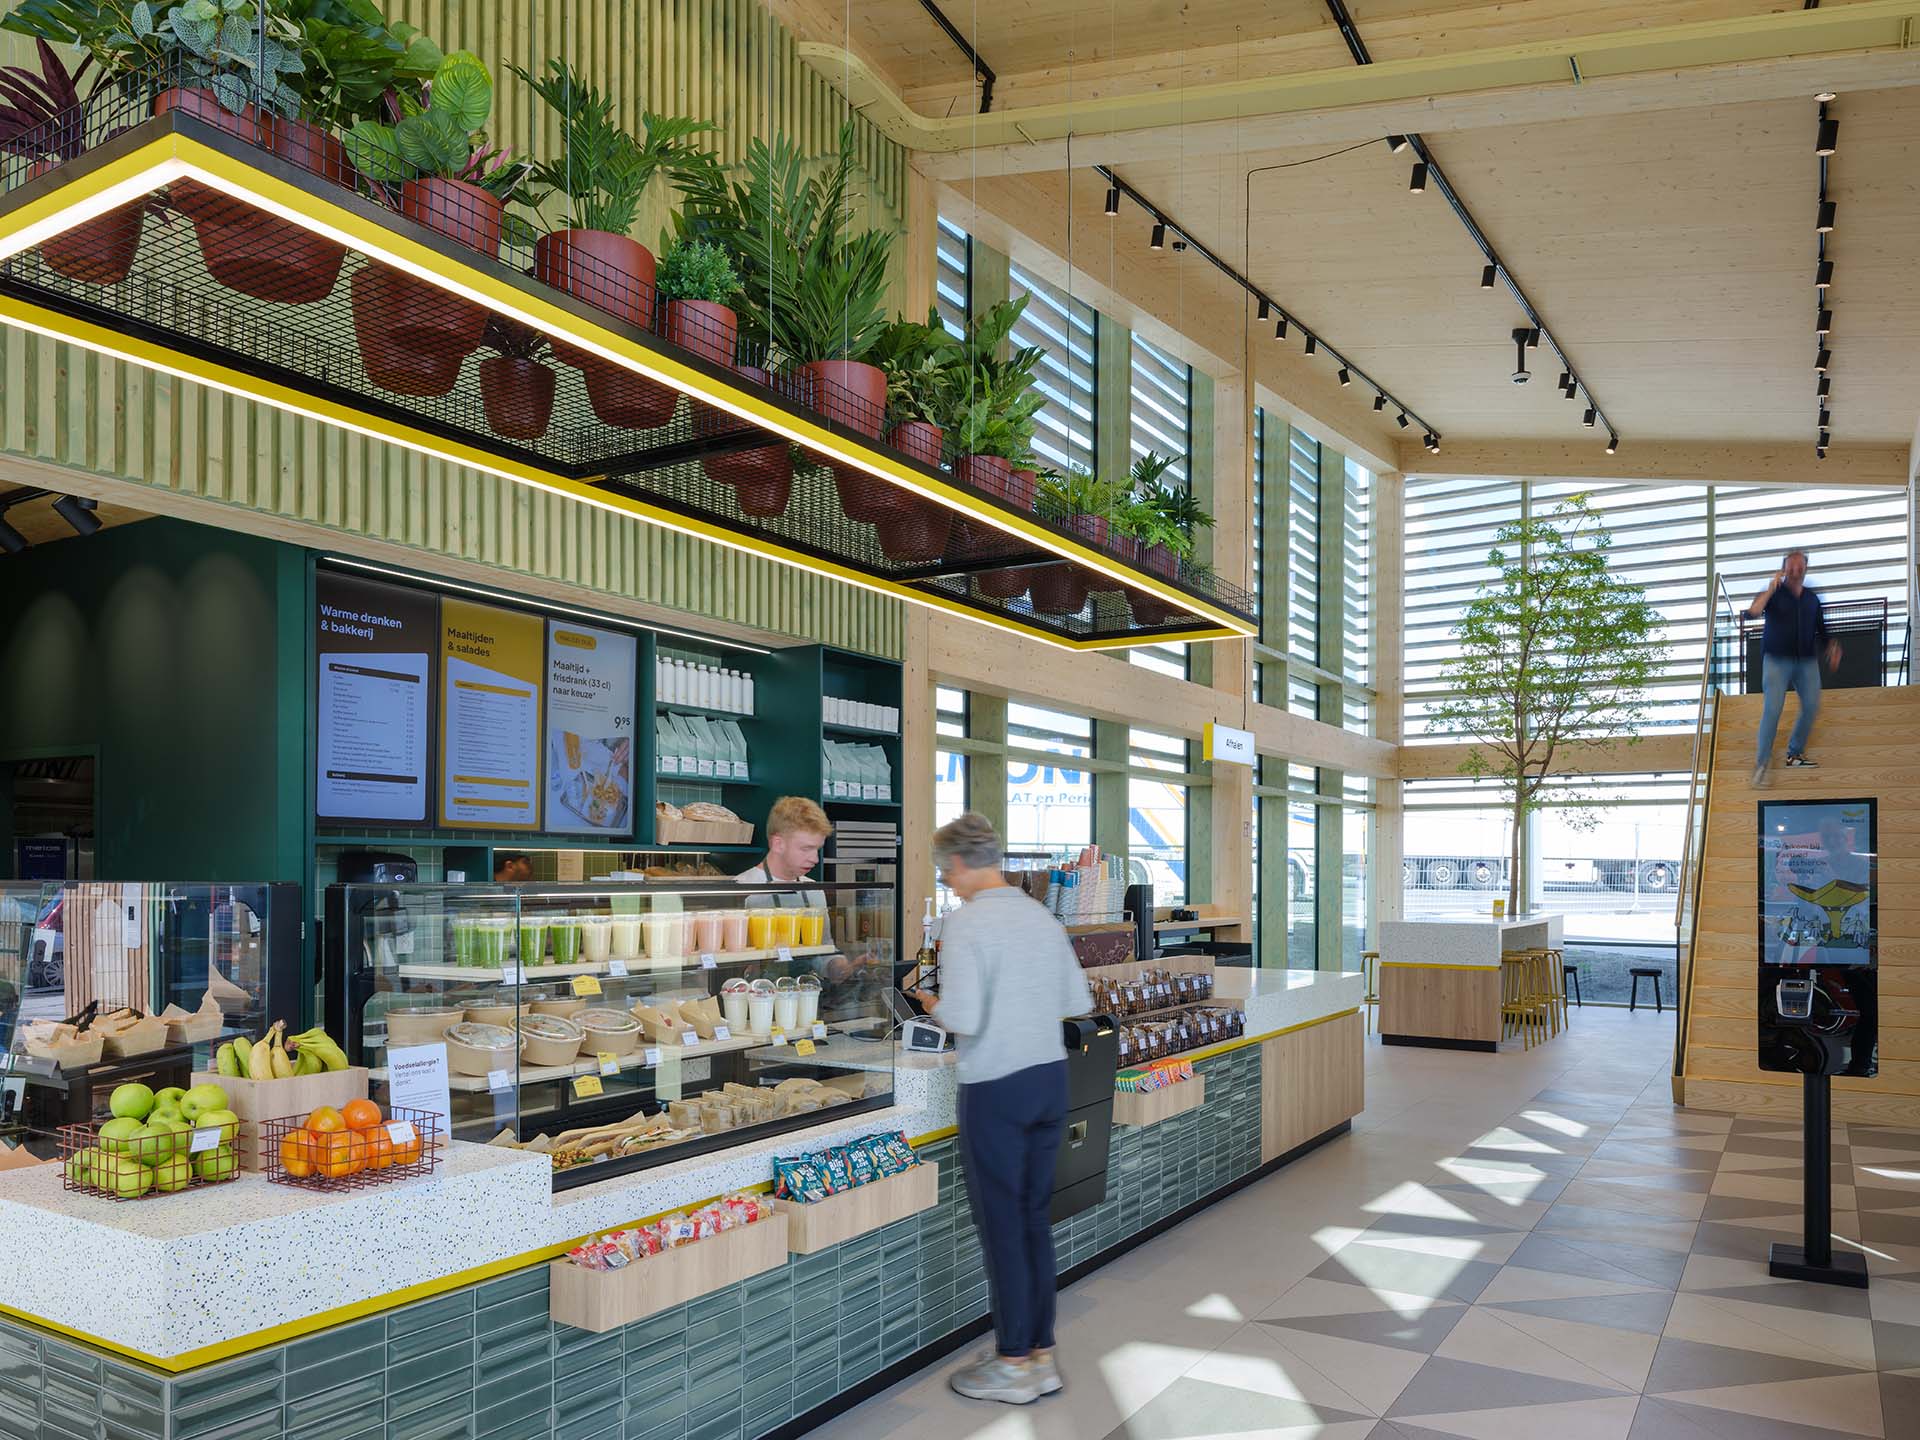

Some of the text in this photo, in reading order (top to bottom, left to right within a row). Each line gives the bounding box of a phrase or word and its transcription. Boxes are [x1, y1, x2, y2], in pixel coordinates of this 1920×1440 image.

[320, 604, 402, 630] Warme dranken
[320, 619, 375, 641] & bakkerij
[447, 627, 494, 646] Maaltijden
[447, 641, 491, 658] & salades
[553, 659, 584, 675] Maaltijd
[553, 673, 588, 688] frisdrank
[588, 676, 602, 689] (33
[553, 685, 571, 697] naar
[393, 1058, 440, 1070] Voedselallergie?
